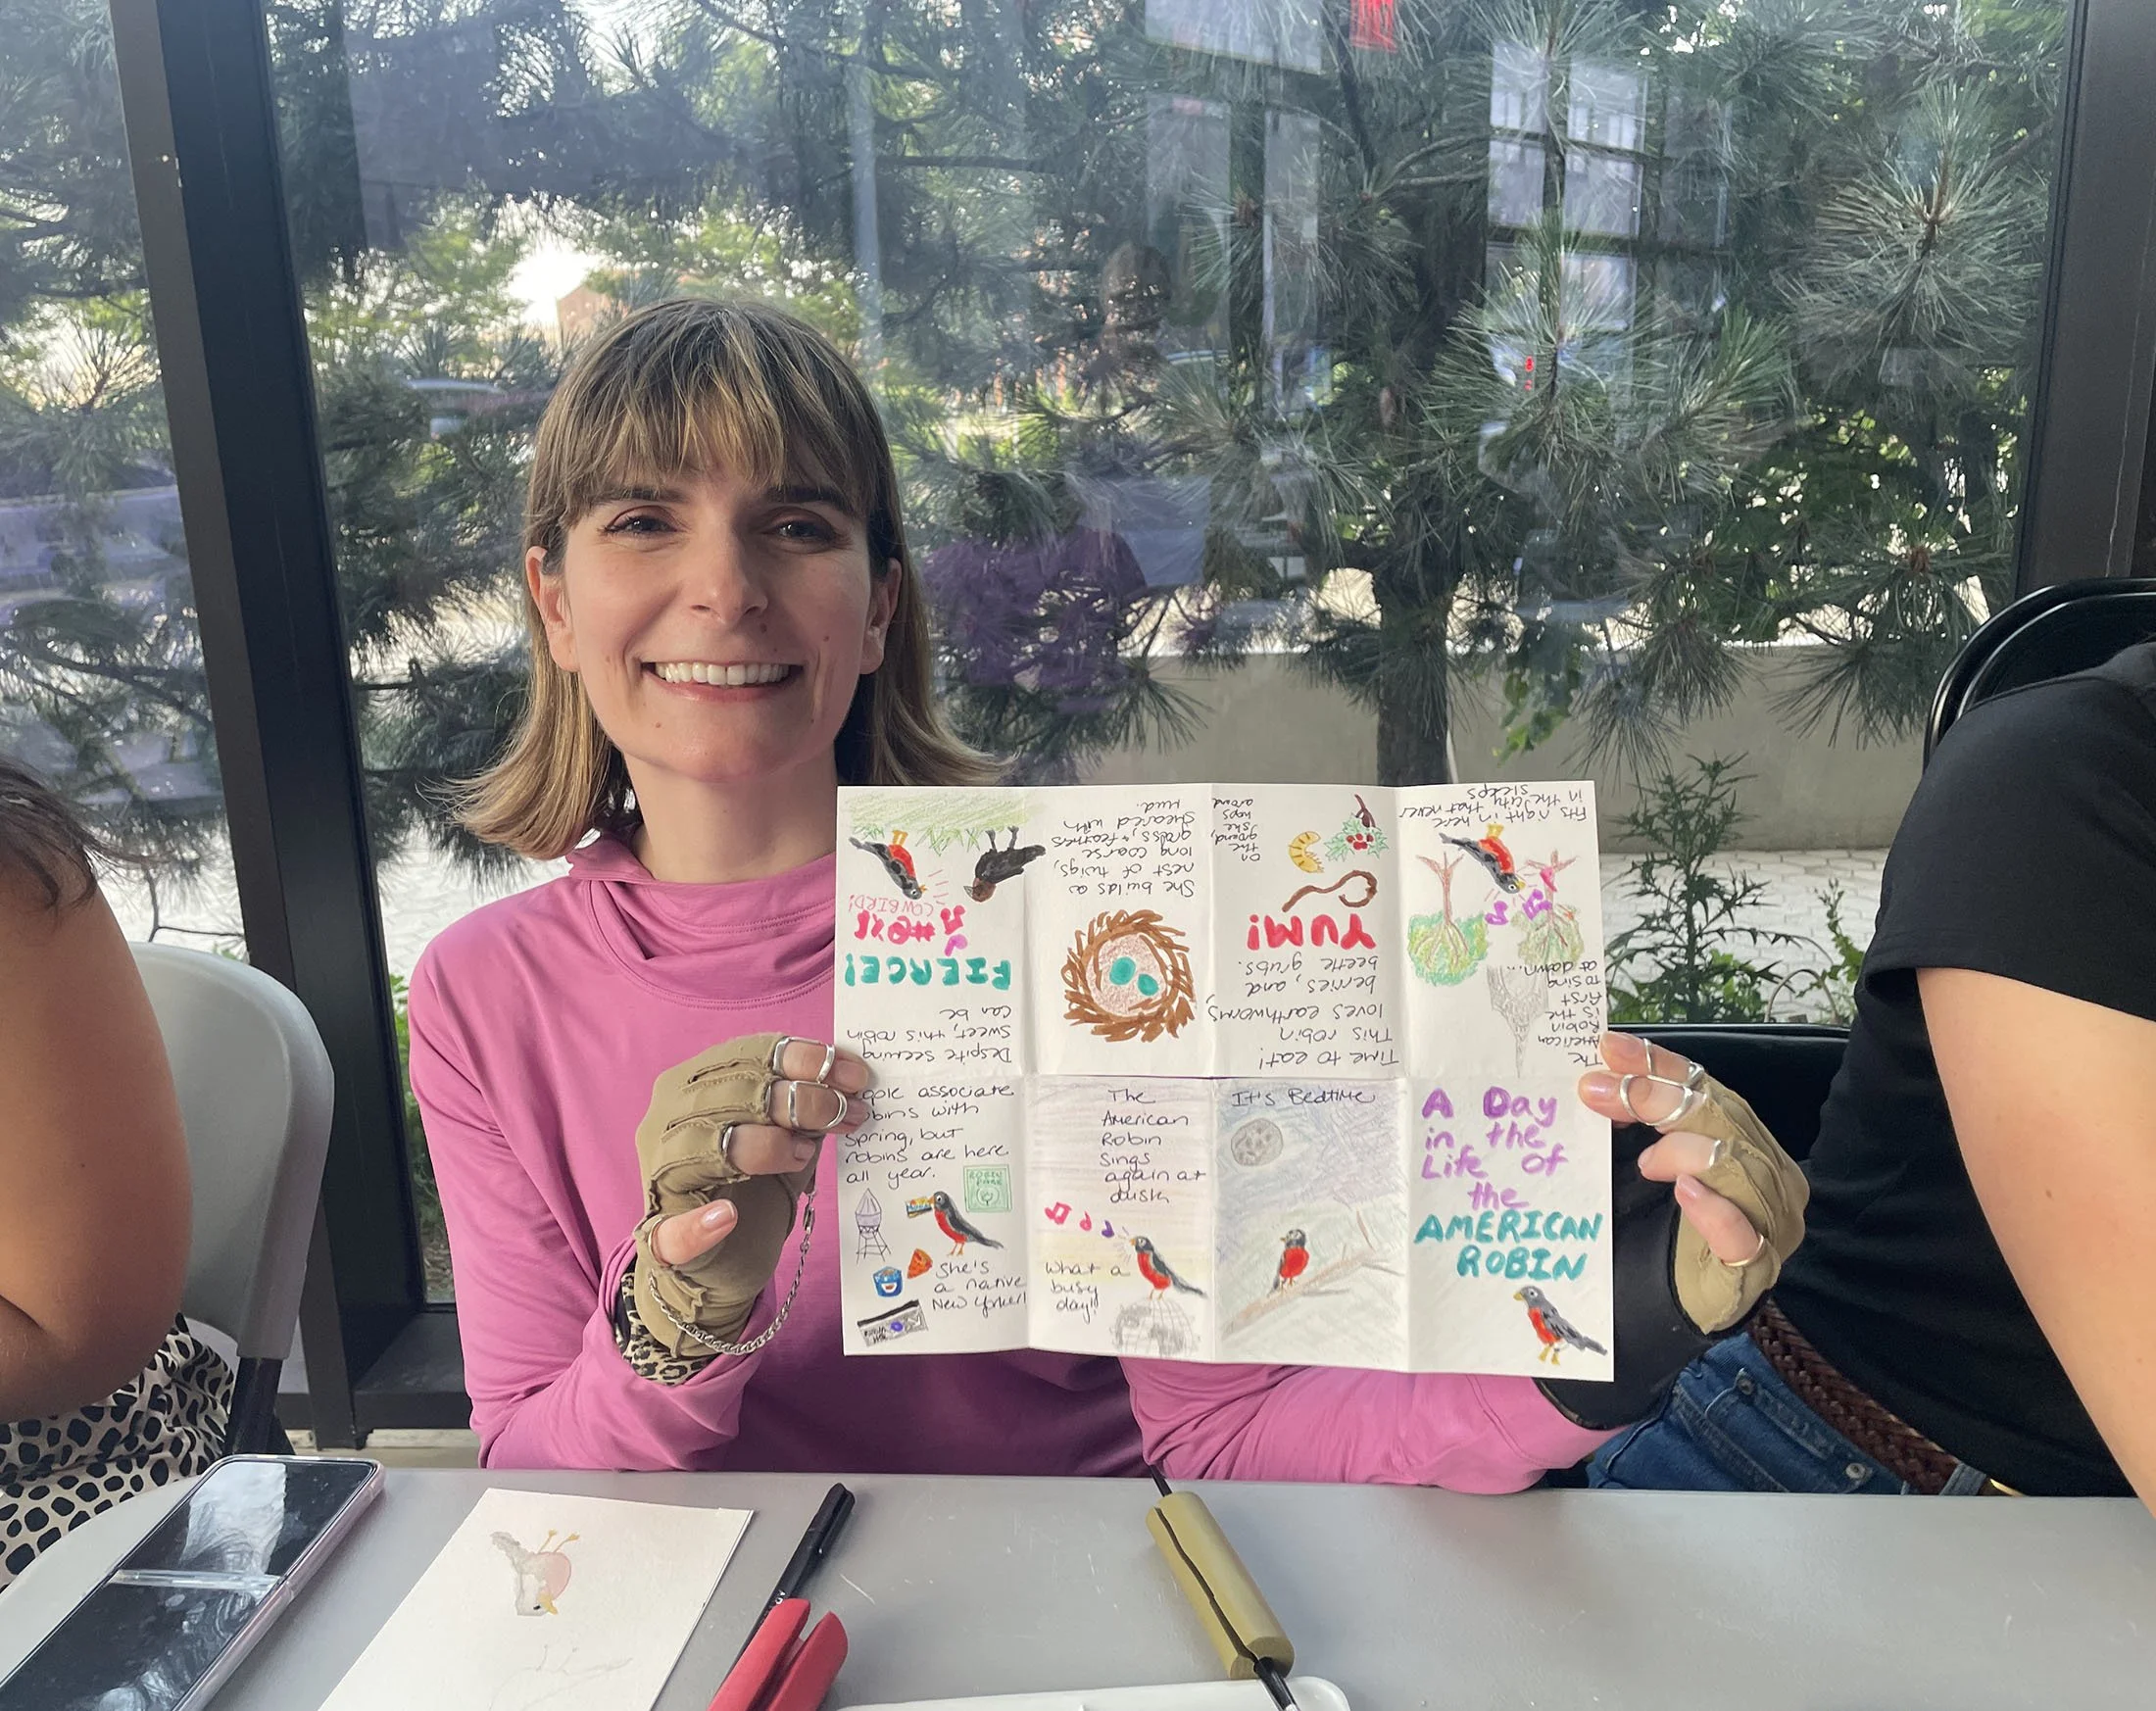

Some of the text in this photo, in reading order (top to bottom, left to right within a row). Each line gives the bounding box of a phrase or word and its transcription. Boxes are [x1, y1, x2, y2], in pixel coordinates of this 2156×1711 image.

[1467, 783, 1528, 799] sleeps
[1569, 790, 1583, 802] in
[1212, 799, 1253, 808] around
[1446, 802, 1484, 813] that
[1531, 794, 1560, 807] the
[1223, 809, 1250, 819] hops
[1399, 806, 1443, 817] never
[1480, 813, 1498, 823] in
[1063, 819, 1102, 833] with
[1223, 822, 1250, 833] she
[1432, 816, 1470, 828] here
[1052, 833, 1119, 847] feathers
[1133, 823, 1191, 842] grass,
[1211, 824, 1257, 845] ground,
[1082, 835, 1192, 859] long coarse
[1229, 844, 1258, 853] the
[1054, 857, 1194, 878] nest of twigs,
[1069, 879, 1195, 898] She builds a
[1247, 913, 1377, 951] YUM!
[845, 953, 1010, 991] FIERCE!
[1239, 952, 1378, 975] beetle grubs.
[1580, 960, 1597, 970] at
[1246, 974, 1376, 997] berries, and
[1561, 992, 1602, 1006] first
[940, 1005, 1011, 1020] can be
[1206, 995, 1383, 1023] loves earthworms,
[1544, 1006, 1599, 1019] is the
[847, 1023, 1010, 1043] sweet, this robin
[1280, 1027, 1393, 1044] This robin
[1552, 1021, 1599, 1033] Robin
[862, 1039, 1011, 1065] Despite seeming
[1260, 1048, 1307, 1070] eat!
[1317, 1051, 1341, 1065] to
[1567, 1052, 1602, 1067] The
[861, 1084, 1014, 1105] ople associate
[1108, 1088, 1156, 1104] The
[1232, 1091, 1275, 1106] It's
[864, 1100, 979, 1121] bins with
[1422, 1086, 1557, 1128] A Day
[1102, 1109, 1189, 1127] American
[920, 1128, 963, 1140] but
[1102, 1132, 1161, 1147] Robin
[1425, 1121, 1546, 1150] in the
[845, 1145, 1009, 1163] robins are here
[1421, 1145, 1489, 1180] Life
[846, 1167, 935, 1190] all year.
[1104, 1169, 1206, 1192] again at
[1110, 1182, 1169, 1203] dusk
[1467, 1182, 1530, 1210] the
[1413, 1209, 1603, 1244] AMERICAN
[1110, 1265, 1130, 1277] a
[1456, 1245, 1588, 1281] ROBIN
[934, 1276, 1027, 1293] a native
[1051, 1280, 1098, 1301] busy
[932, 1295, 967, 1310] New
